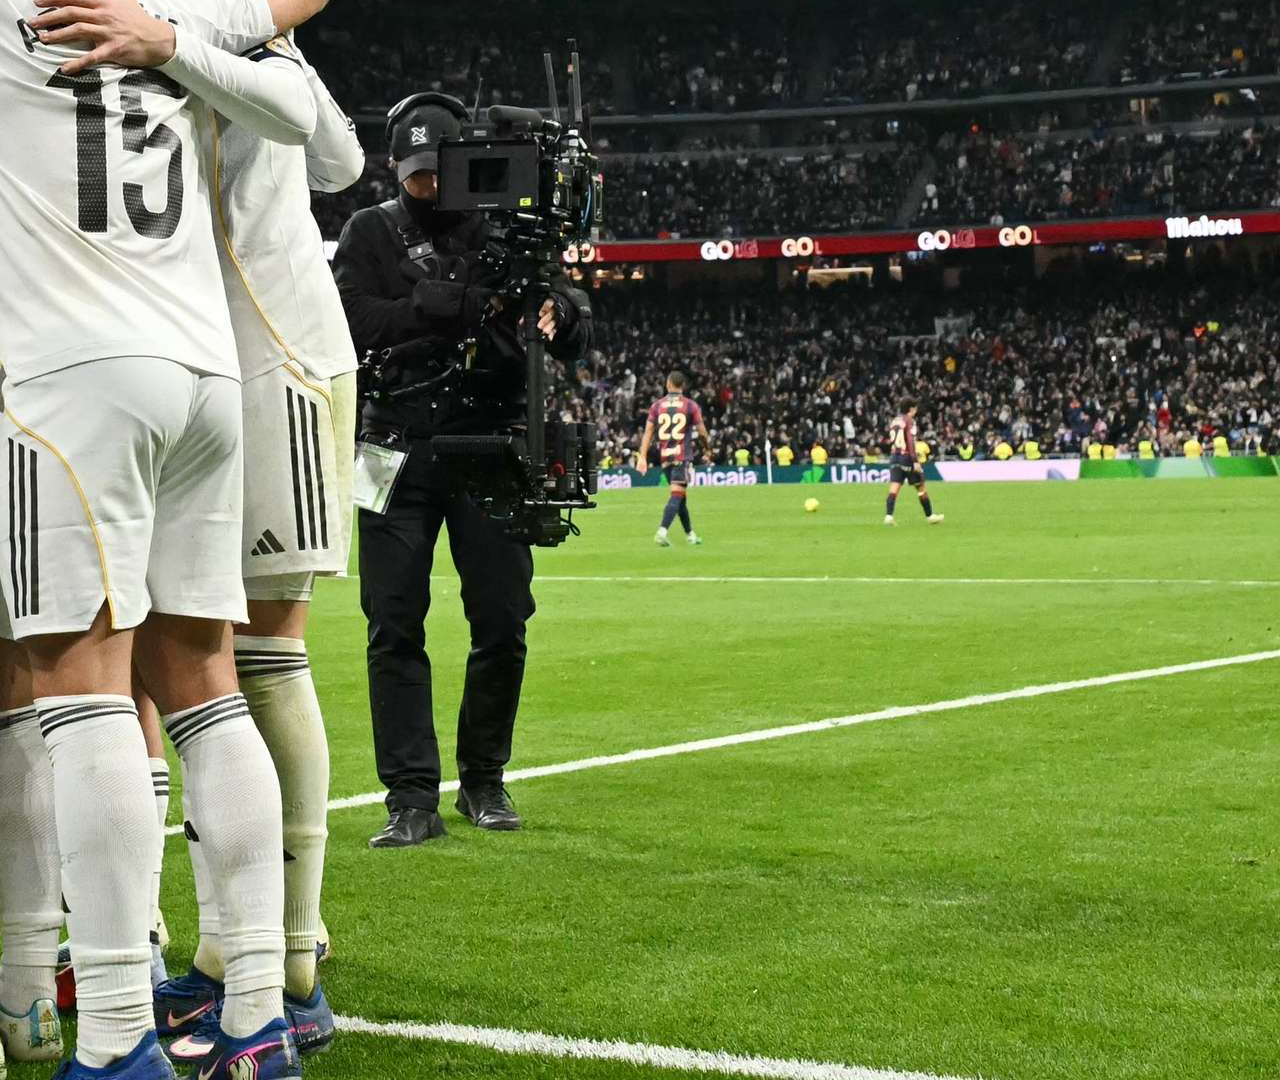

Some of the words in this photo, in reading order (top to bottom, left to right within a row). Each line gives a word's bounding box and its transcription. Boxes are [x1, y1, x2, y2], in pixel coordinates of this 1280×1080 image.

[45, 67, 187, 240] 15
[999, 225, 1041, 247] GOL
[1165, 215, 1242, 239] Mahou
[781, 236, 823, 258] GOL
[658, 413, 687, 440] 22
[830, 465, 891, 484] Unica
